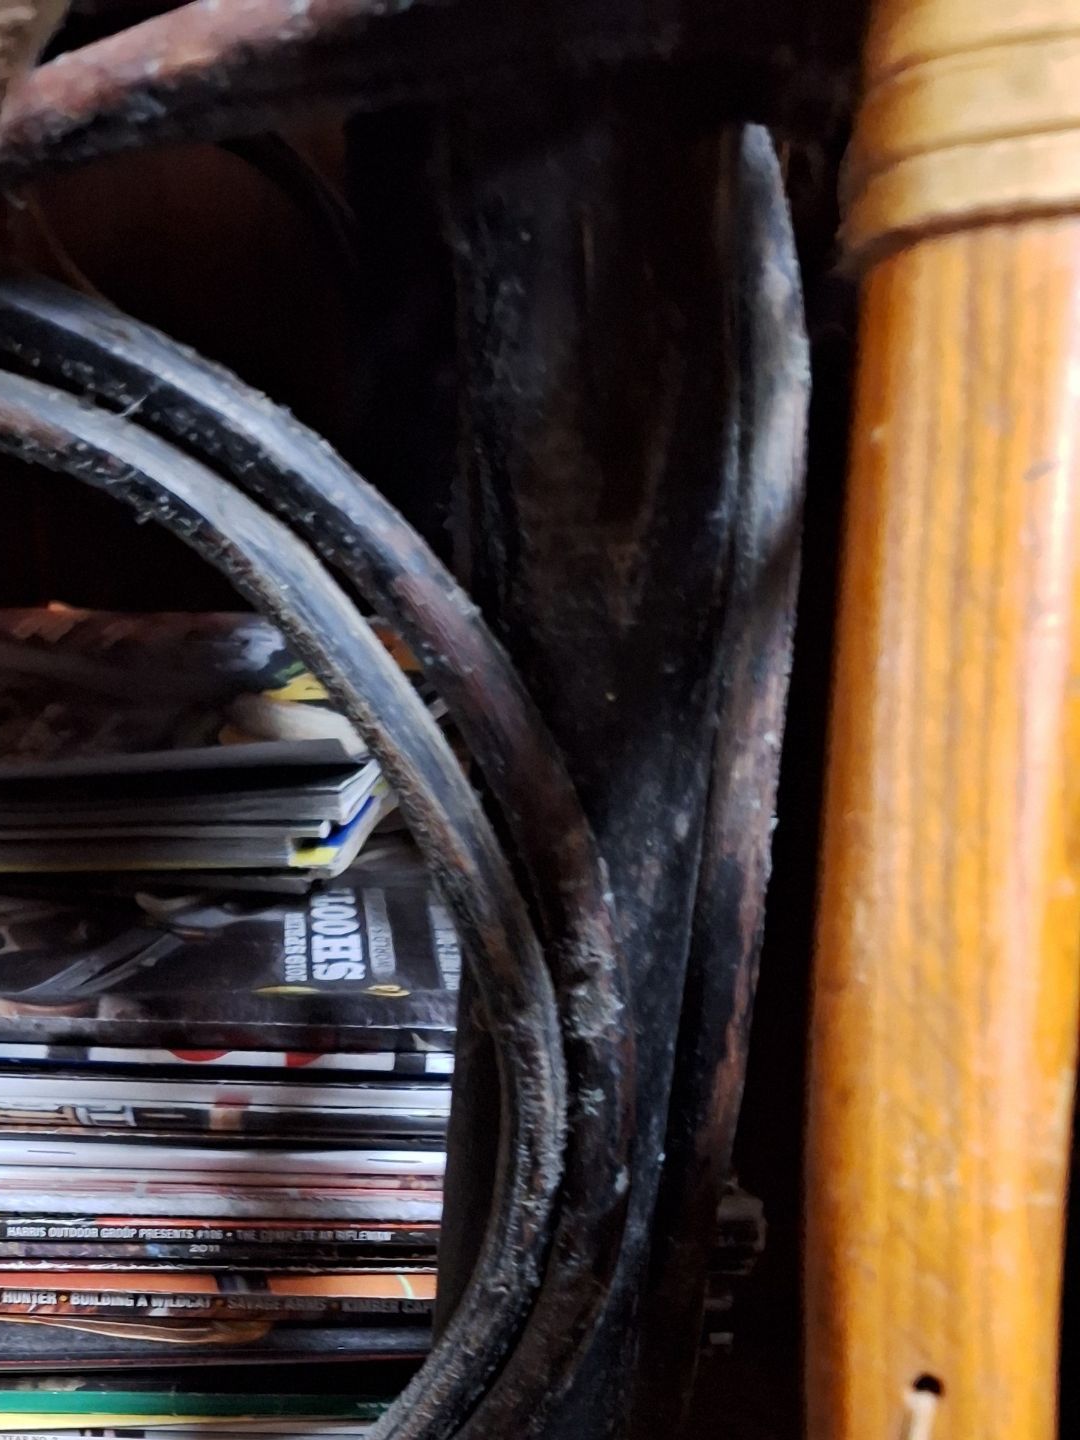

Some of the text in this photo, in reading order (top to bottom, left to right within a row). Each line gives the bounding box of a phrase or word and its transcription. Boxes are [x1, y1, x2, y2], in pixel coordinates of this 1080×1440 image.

[6, 1226, 46, 1237] HARRIS
[48, 1227, 99, 1238] OUTDOOR
[100, 1227, 137, 1239] GROUP
[138, 1228, 195, 1239] PRESENTS
[2, 1290, 57, 1305] HUNTER
[71, 1292, 134, 1307] BUILDING
[150, 1295, 211, 1308] WILDCAT
